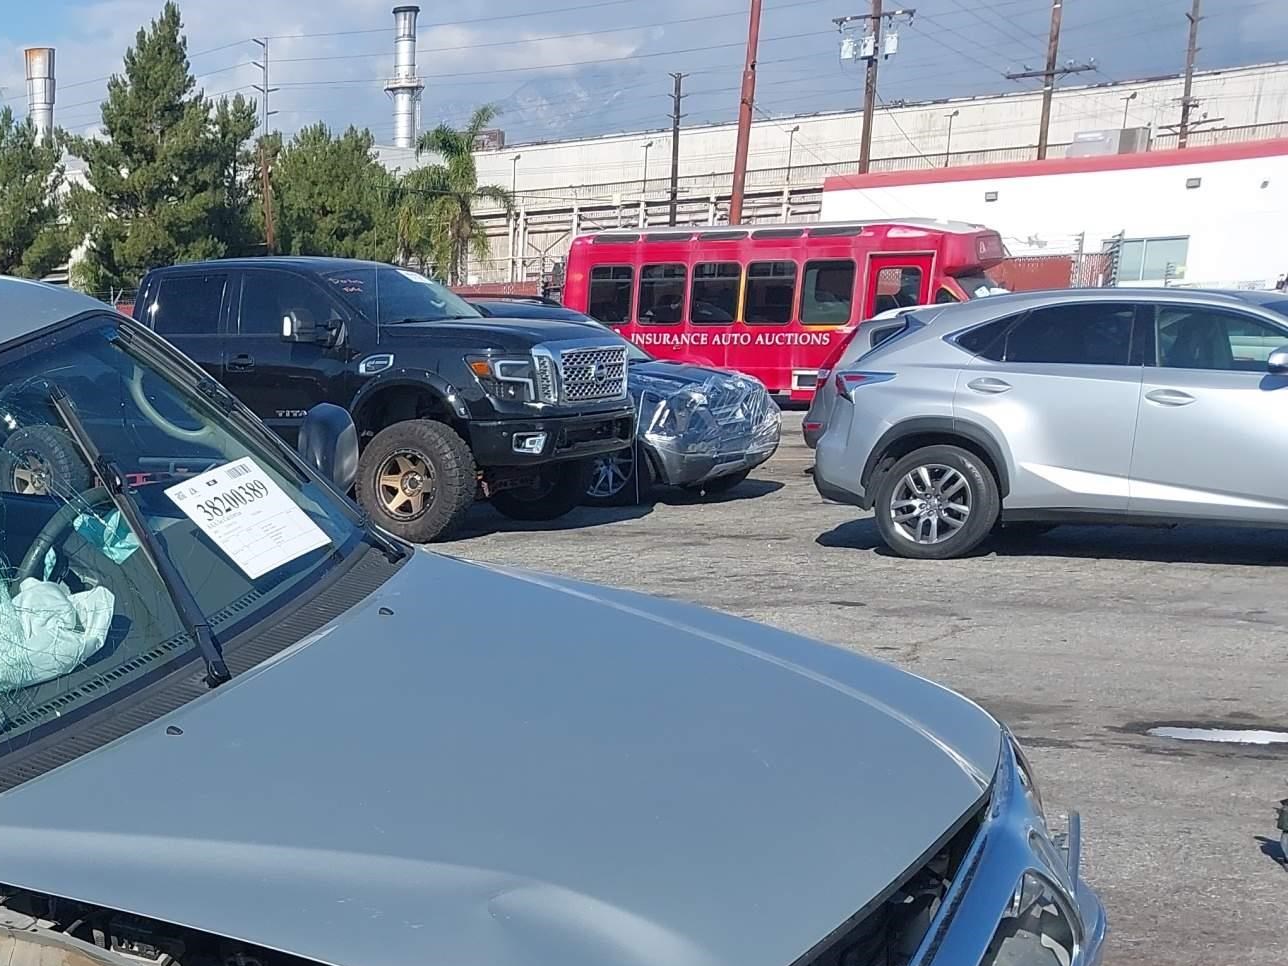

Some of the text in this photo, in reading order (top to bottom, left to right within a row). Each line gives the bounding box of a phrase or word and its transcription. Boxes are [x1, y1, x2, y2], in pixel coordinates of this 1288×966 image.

[631, 333, 830, 345] INSURANCE AUTO AUCTIONS
[275, 409, 309, 417] TITA
[196, 479, 269, 521] 38200389
